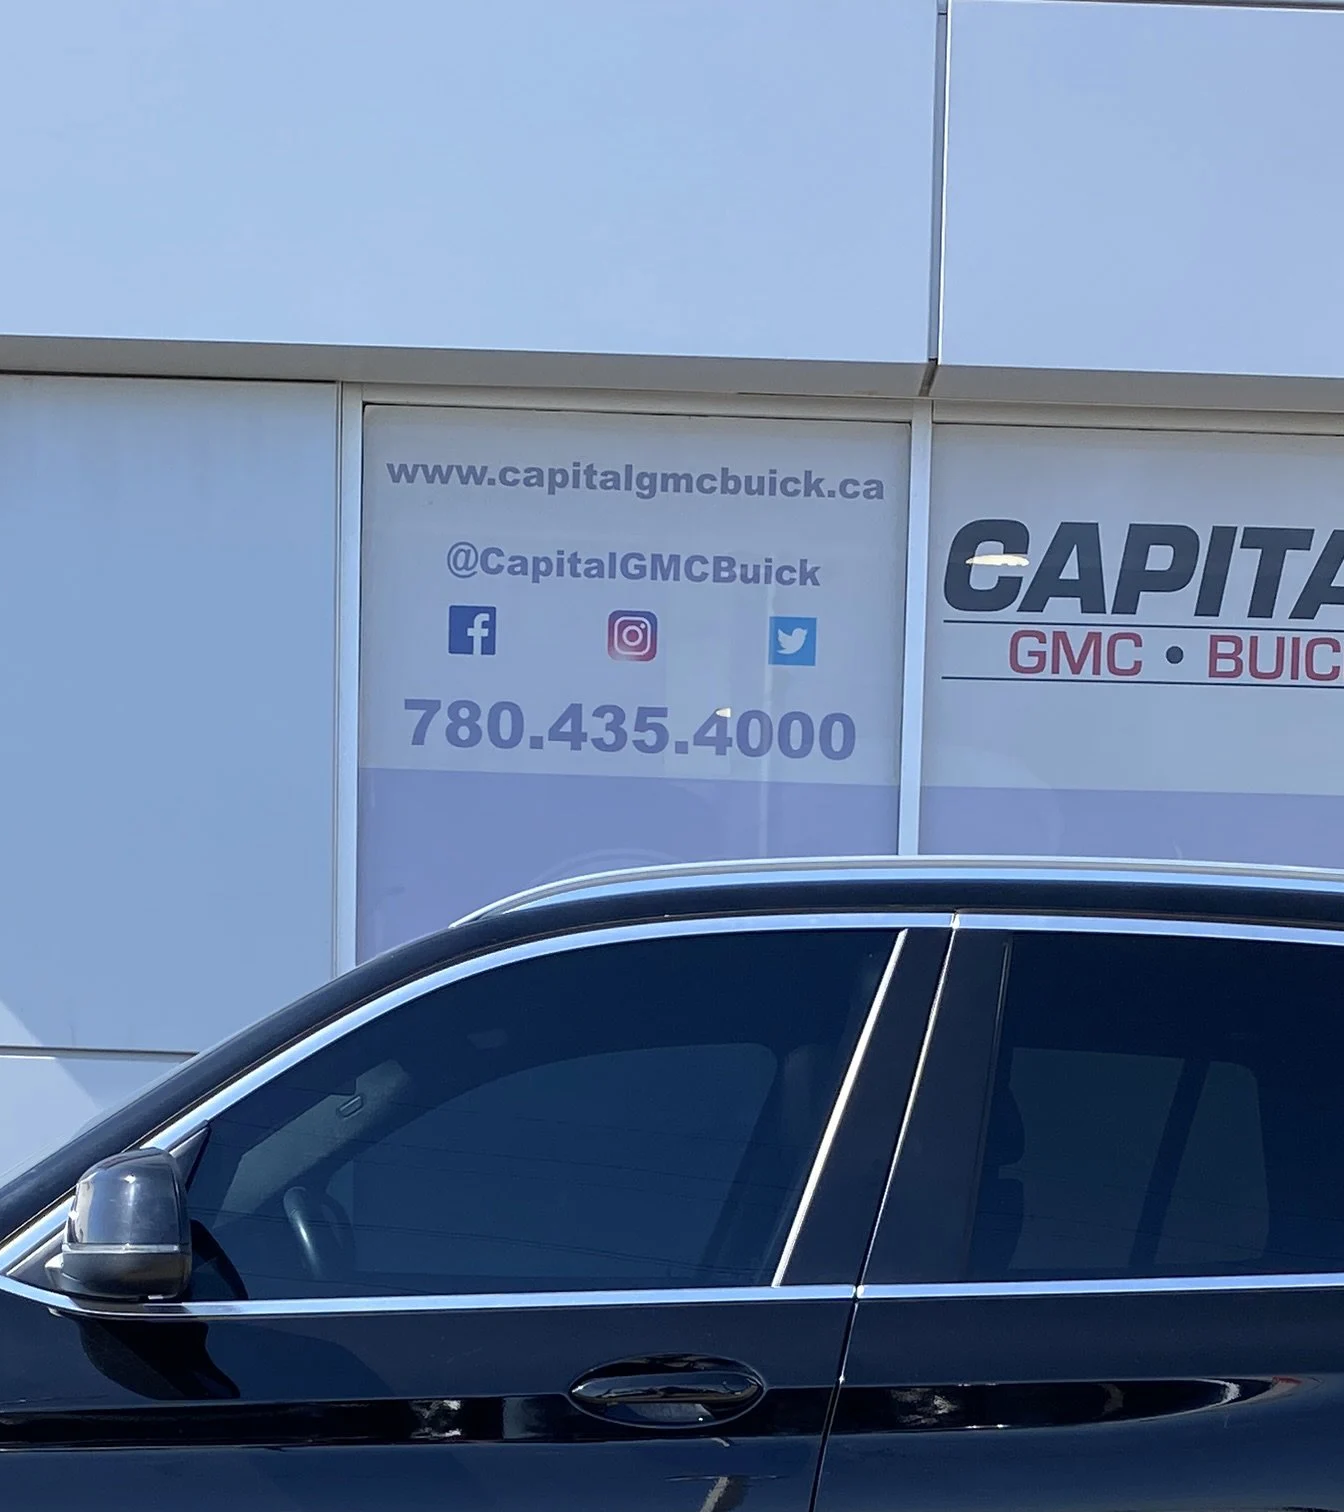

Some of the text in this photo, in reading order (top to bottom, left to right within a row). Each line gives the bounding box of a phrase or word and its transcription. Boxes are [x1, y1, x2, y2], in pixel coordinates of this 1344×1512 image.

[386, 461, 886, 500] www.capitalgmcbuick.ca
[446, 541, 822, 588] @CapitalGMCBuick
[1009, 629, 1143, 677] GMC
[403, 699, 857, 762] 780.435.4000
